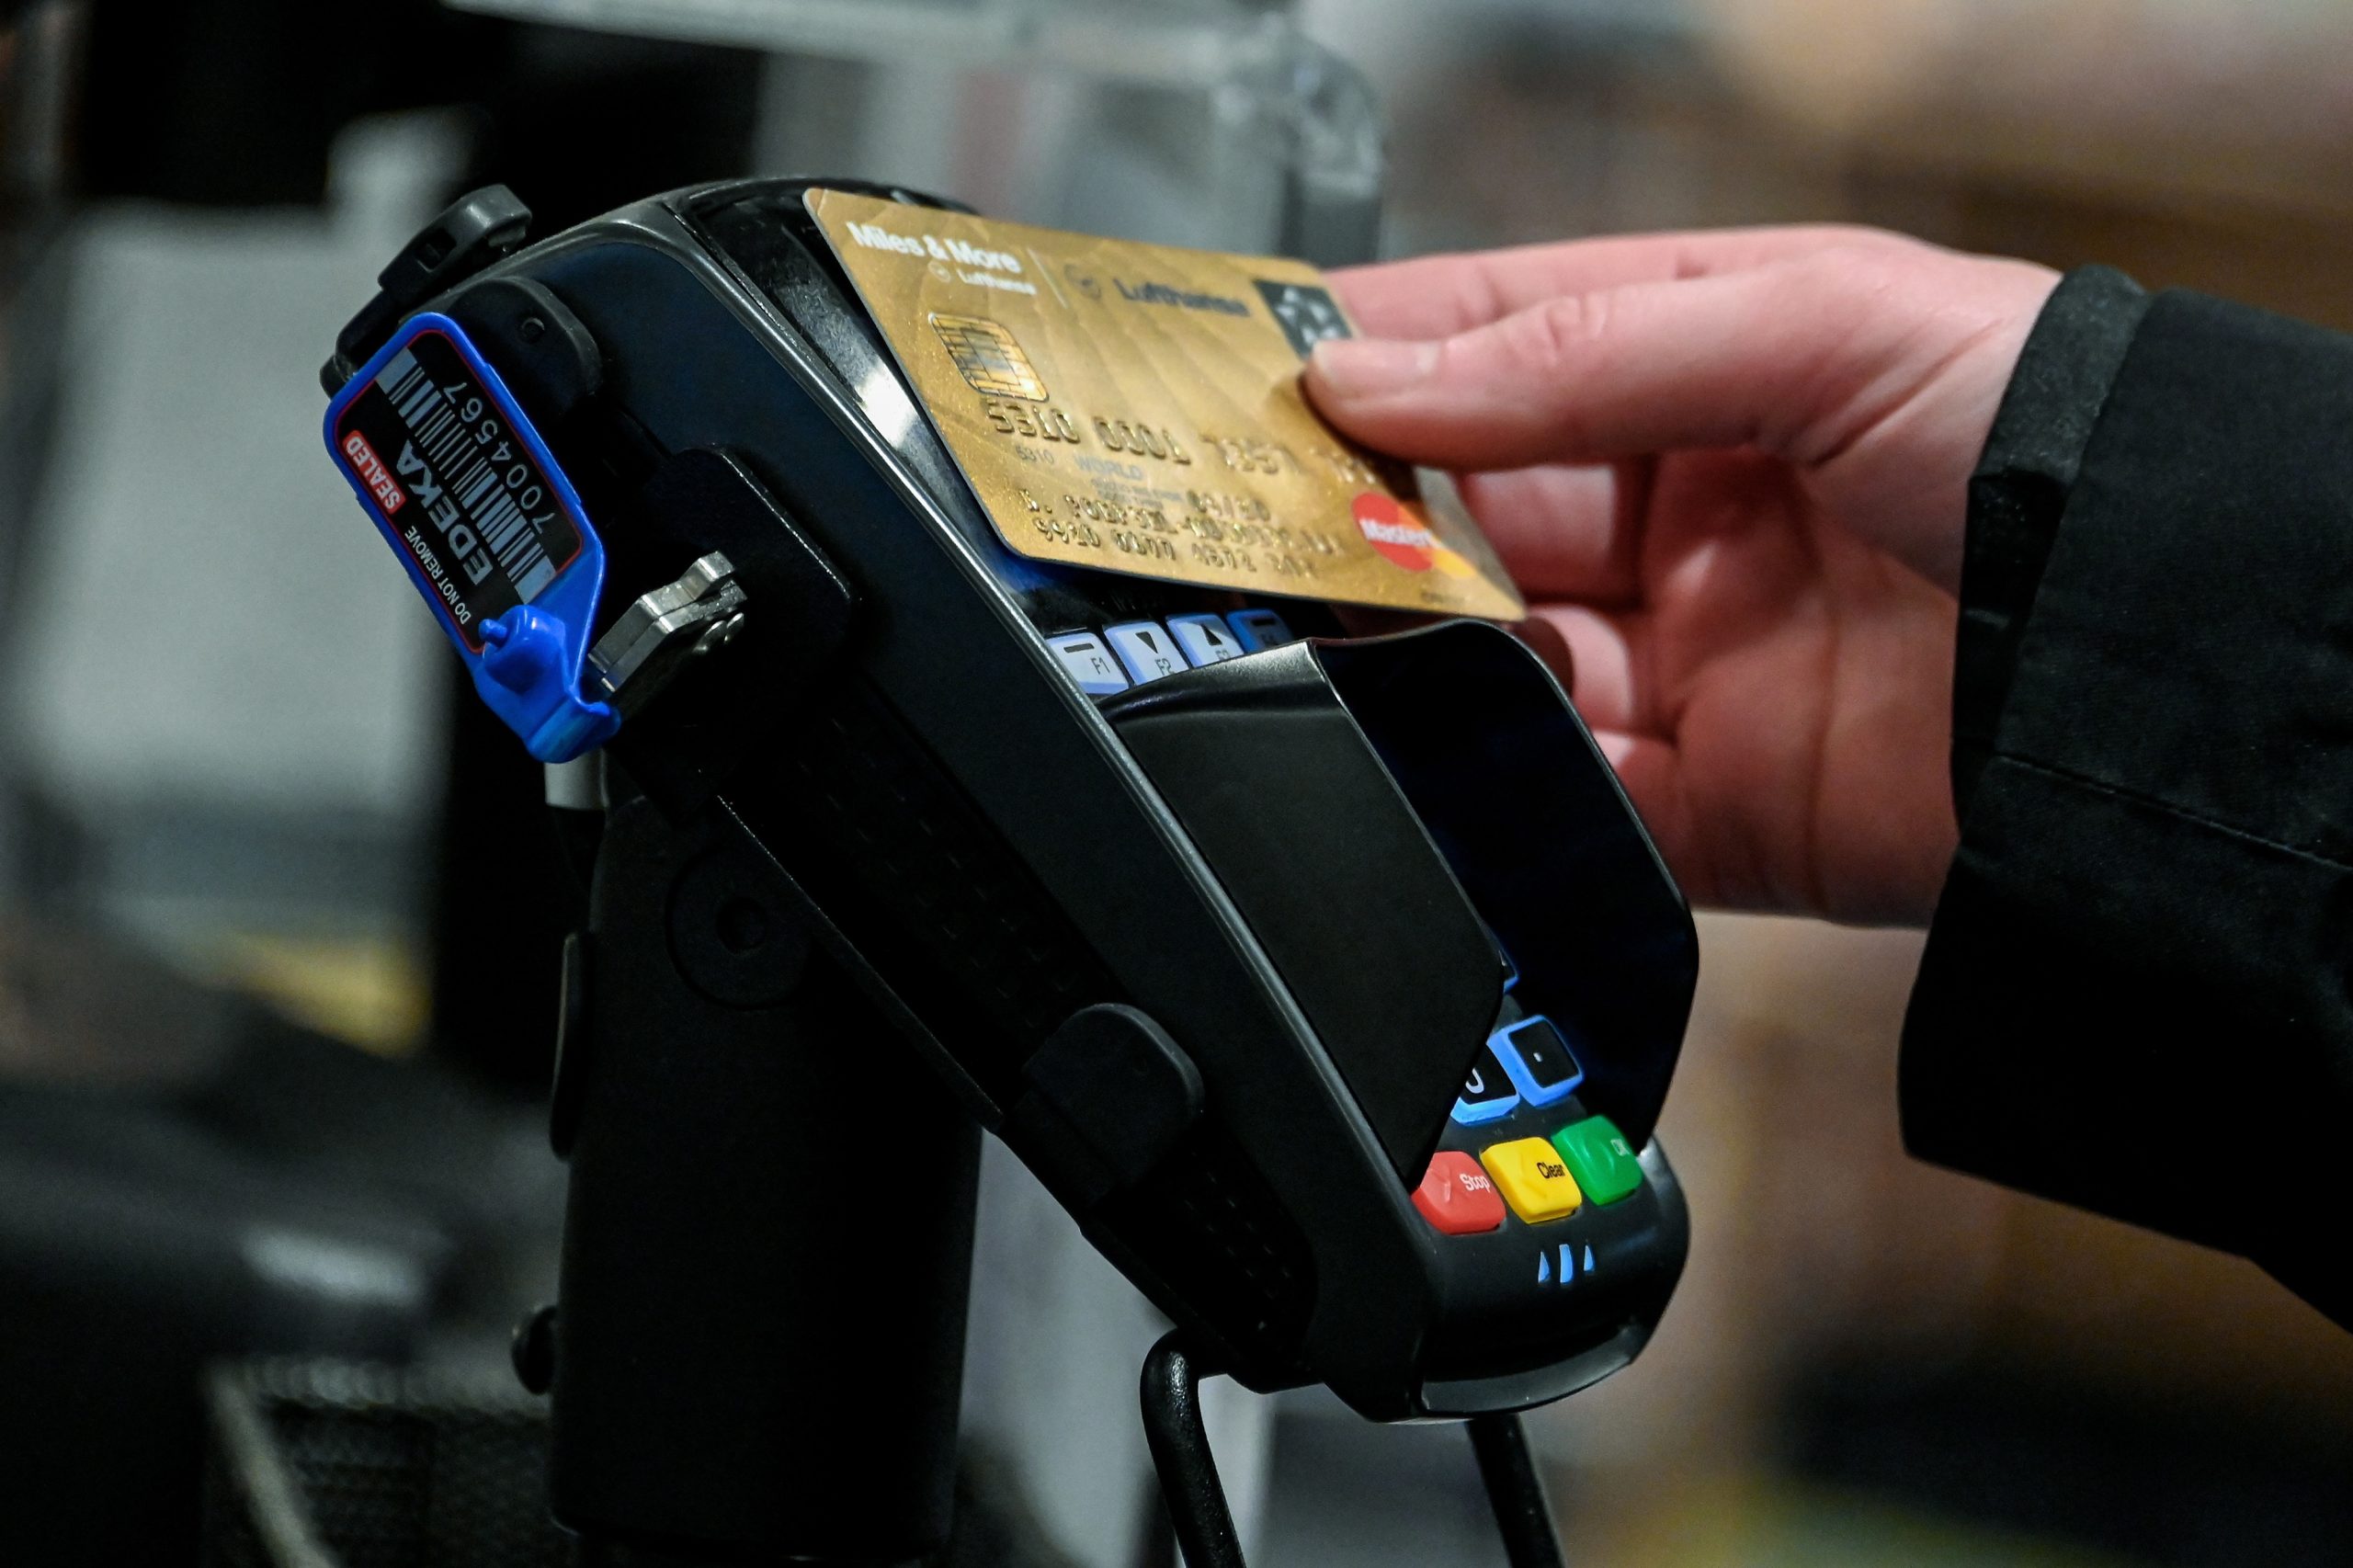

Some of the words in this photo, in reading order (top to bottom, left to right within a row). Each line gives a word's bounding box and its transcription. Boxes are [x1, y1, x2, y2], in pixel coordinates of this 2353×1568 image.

[846, 221, 926, 258] Miles
[922, 234, 949, 261] &
[945, 238, 1021, 275] More
[346, 436, 402, 510] SEALED
[1074, 454, 1143, 481] WORLD
[396, 440, 494, 585] EDEKA
[1358, 517, 1436, 548] Master
[404, 525, 443, 580] REMOVE
[438, 577, 460, 605] NOT
[454, 602, 472, 625] DO
[1090, 656, 1111, 676] F1
[1154, 657, 1176, 676] F2
[1459, 1172, 1491, 1194] Stop
[1536, 1161, 1566, 1180] Clear
